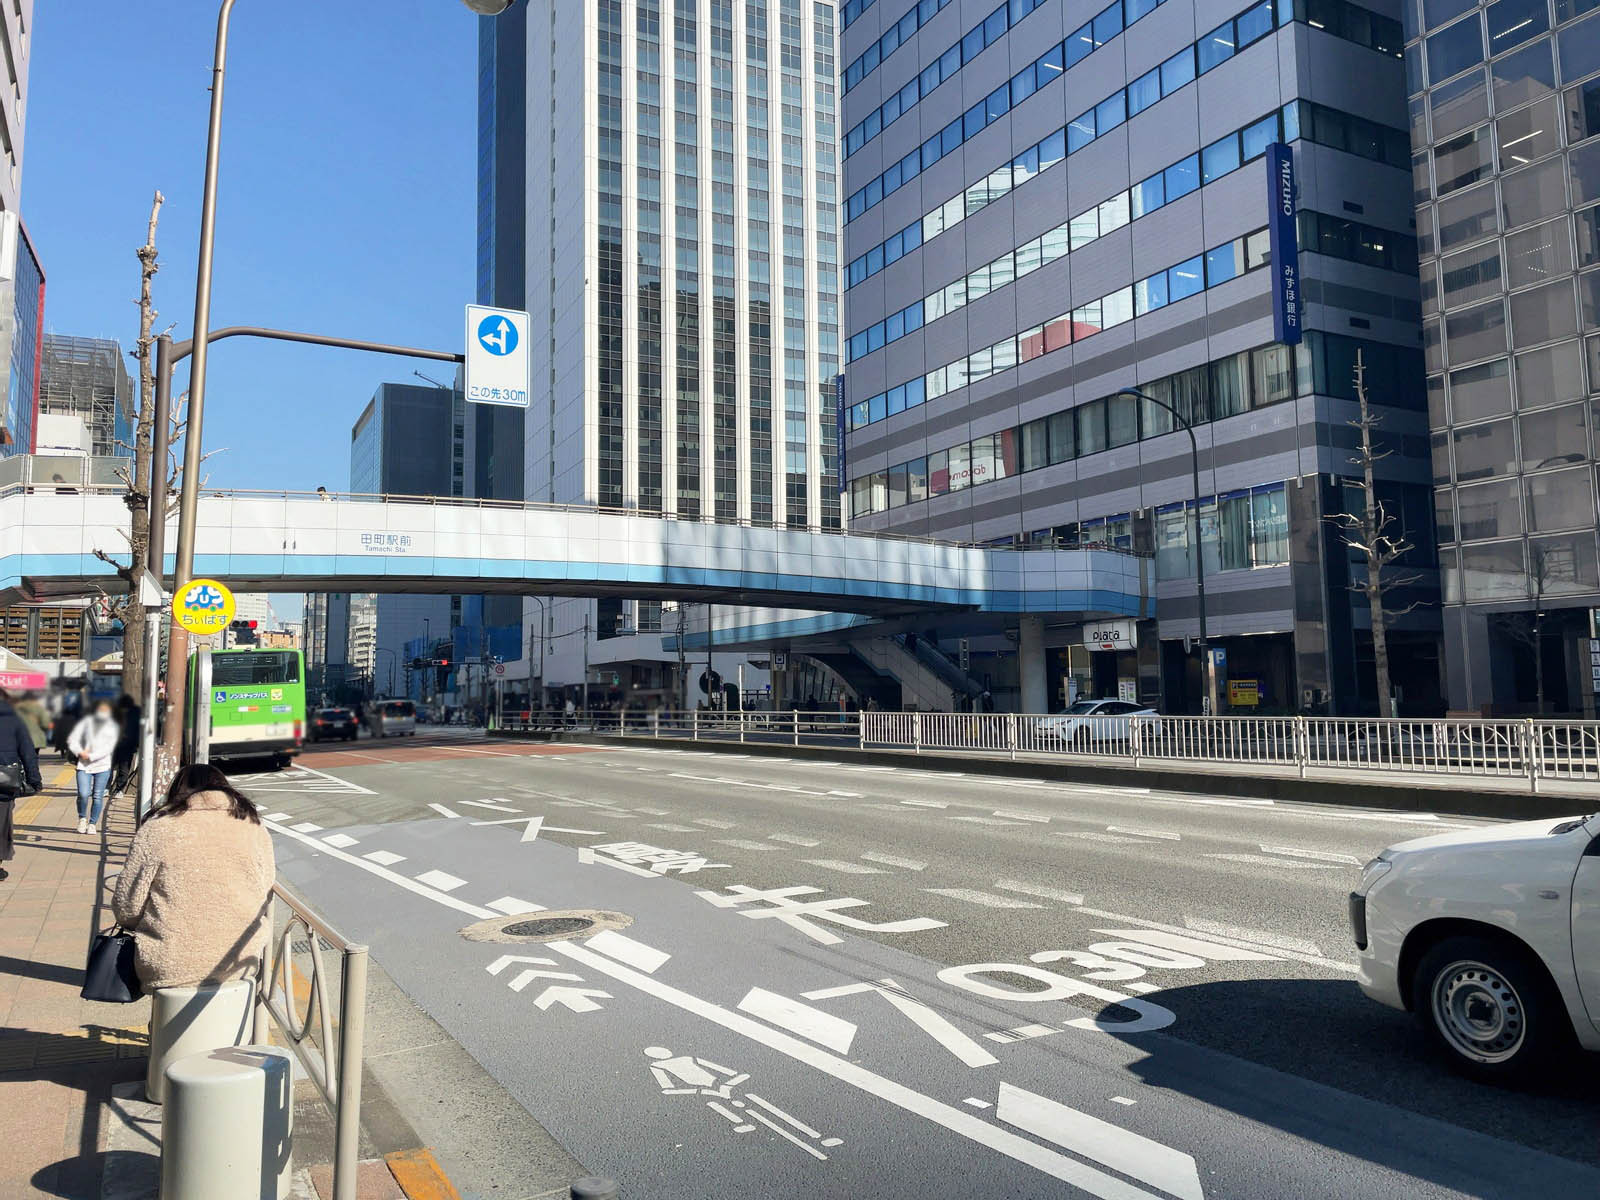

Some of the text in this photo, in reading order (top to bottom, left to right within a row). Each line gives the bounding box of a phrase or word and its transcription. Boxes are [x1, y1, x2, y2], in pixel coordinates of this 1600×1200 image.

[1282, 159, 1293, 216] MIZUHO
[1285, 265, 1296, 327] みずほ銀行
[471, 386, 526, 402] この先30m
[361, 533, 411, 546] 田町駅前
[365, 545, 393, 553] Tamachi
[1093, 630, 1120, 642] plata
[1216, 651, 1225, 664] P
